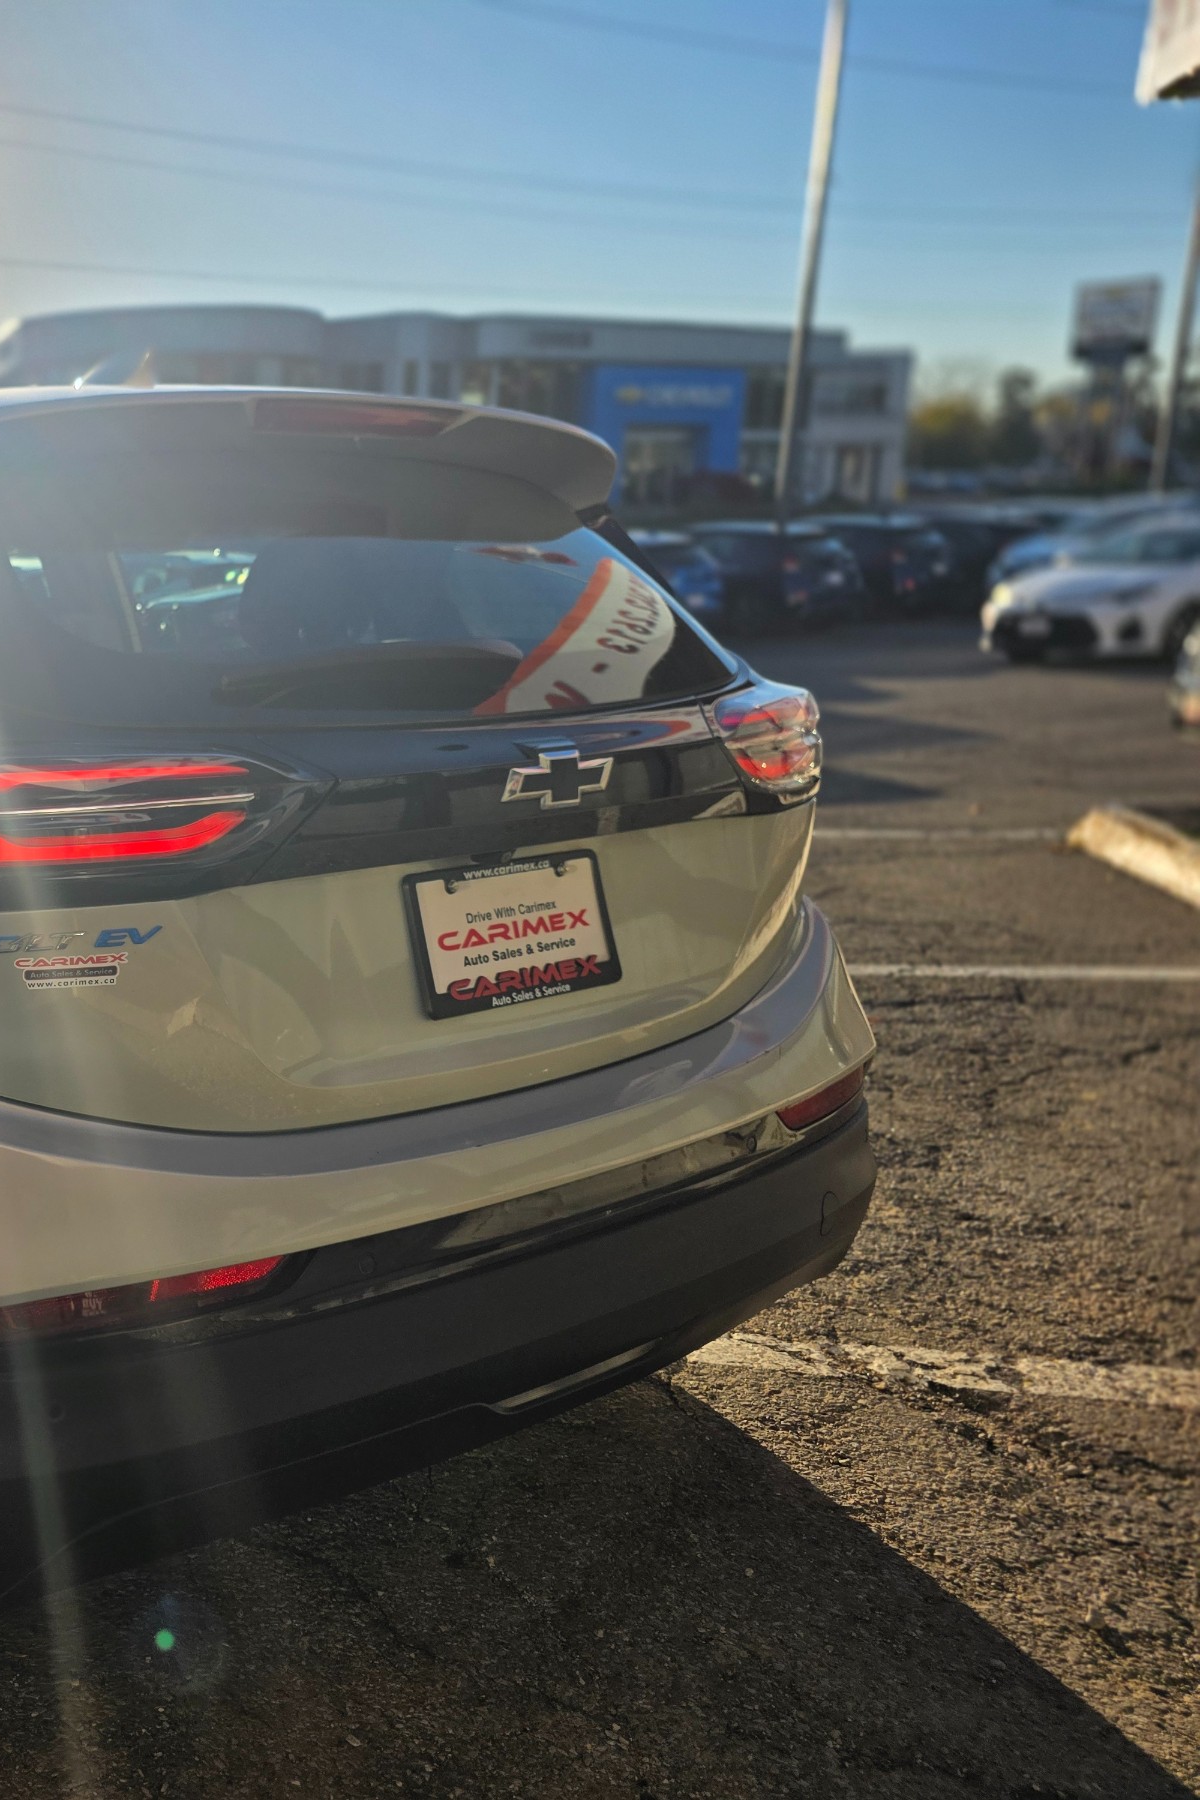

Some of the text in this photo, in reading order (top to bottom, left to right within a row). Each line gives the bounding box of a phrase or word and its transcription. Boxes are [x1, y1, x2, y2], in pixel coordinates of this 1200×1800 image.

[464, 861, 549, 878] www.carimex.ca
[466, 900, 557, 924] Drive With Carimex
[94, 925, 163, 948] EV
[437, 909, 589, 951] CARIMEX
[15, 953, 127, 968] CARIMEX
[464, 937, 576, 967] Auto Sales & Service
[27, 978, 115, 988] www.carimex.ca
[30, 967, 113, 979] Auto Sales & Service
[448, 956, 600, 1000] CARIMEX
[492, 983, 571, 1007] Auto Sales & Service
